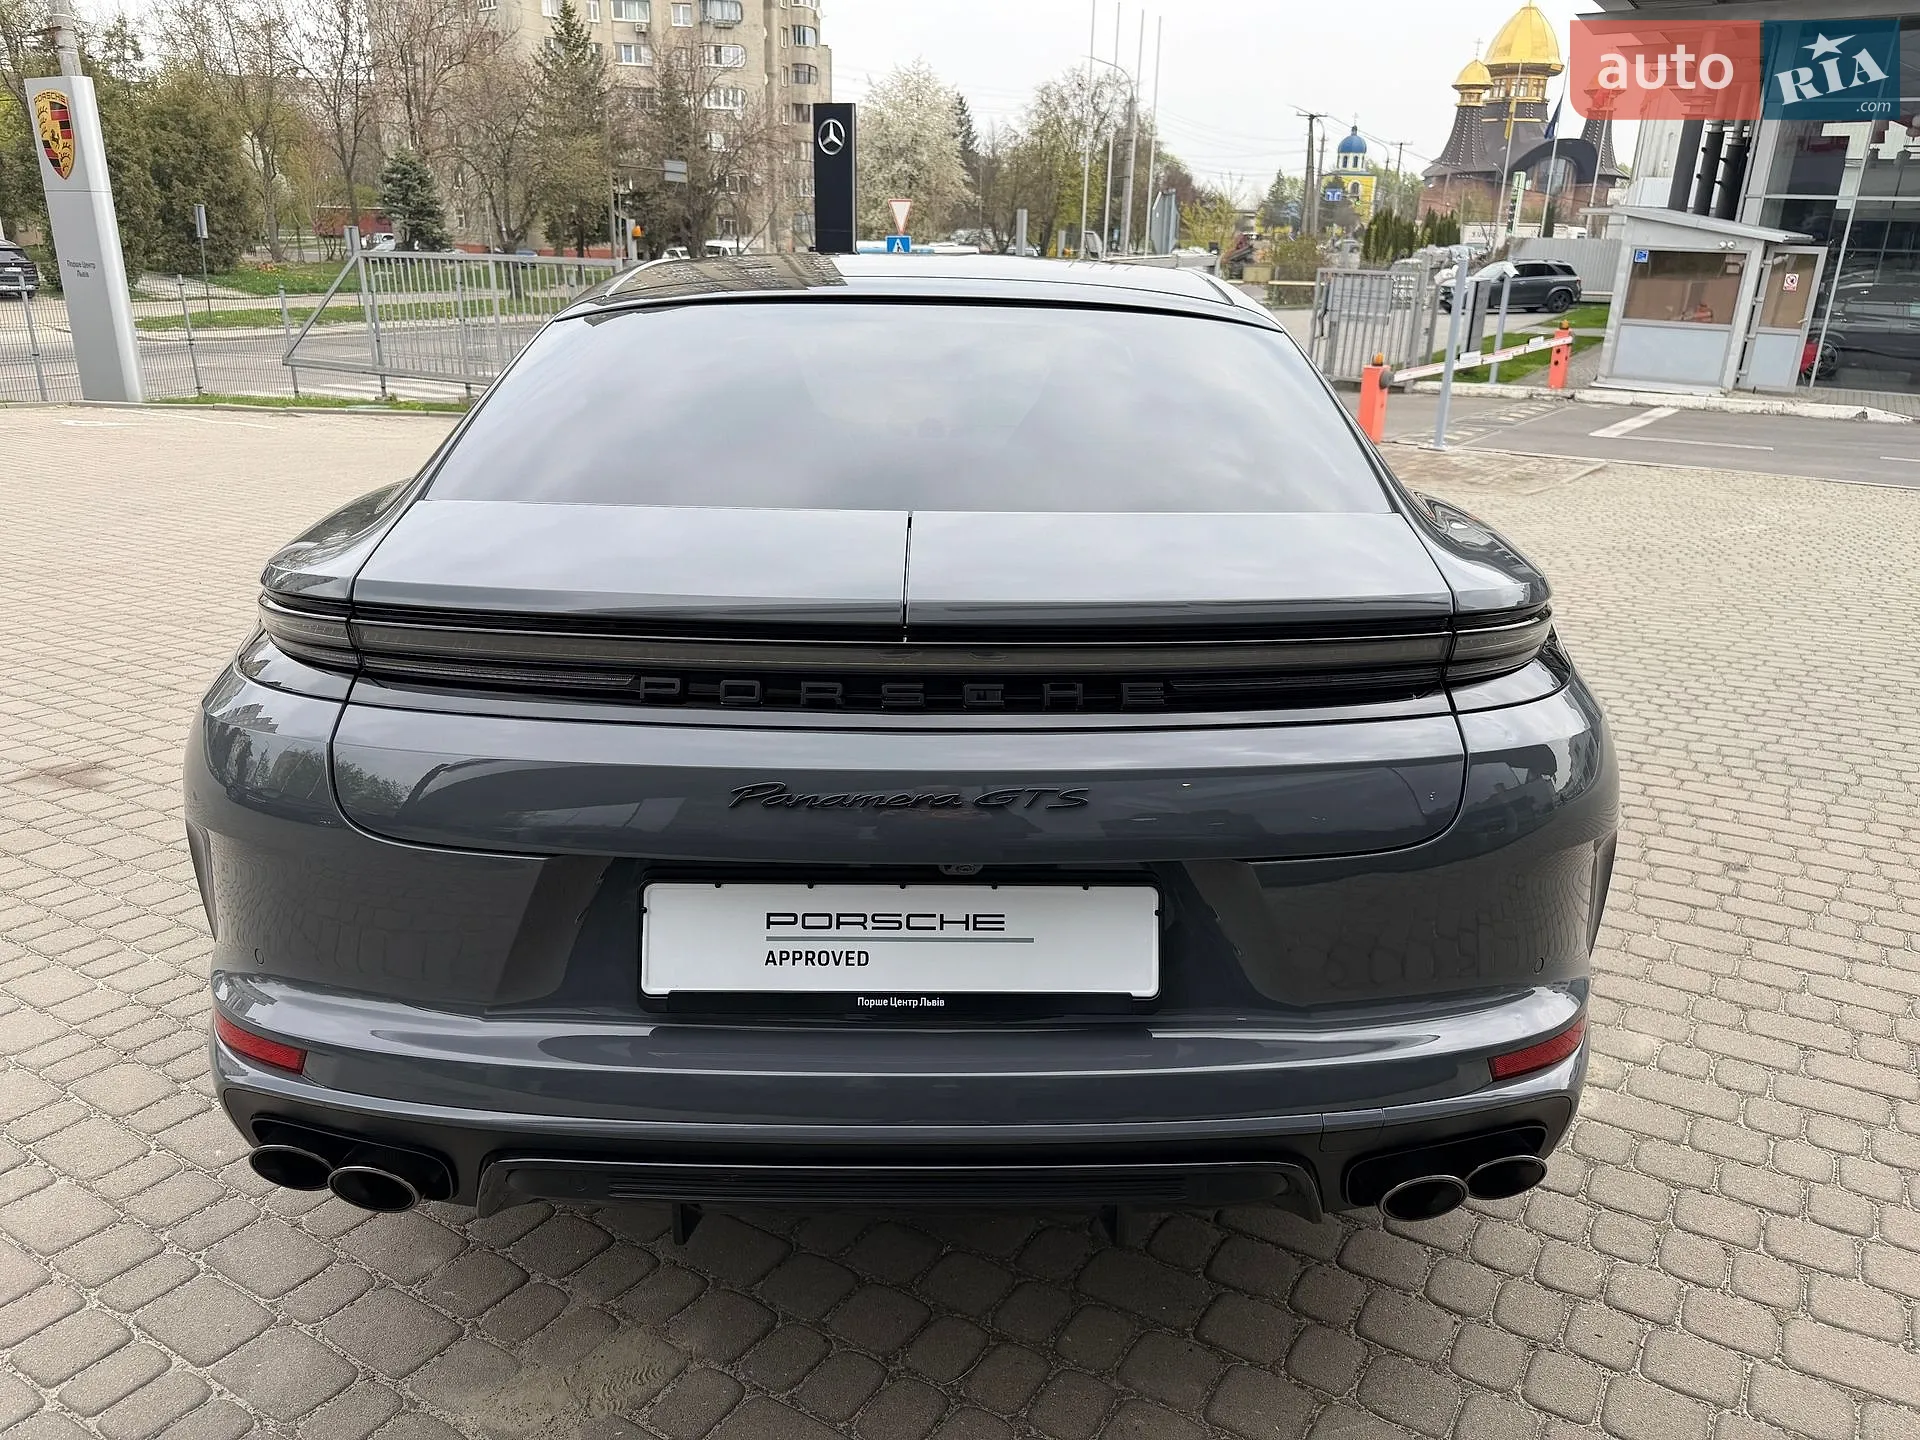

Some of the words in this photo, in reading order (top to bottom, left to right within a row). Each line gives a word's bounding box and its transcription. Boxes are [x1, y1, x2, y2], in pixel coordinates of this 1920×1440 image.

[638, 676, 1167, 710] PORSCHE
[728, 781, 963, 809] Panamera
[973, 787, 1090, 809] GTS
[765, 912, 1006, 931] PORSCHE
[764, 950, 870, 967] APPROVED
[857, 996, 889, 1009] Порше
[889, 996, 918, 1009] Центр
[919, 996, 945, 1007] Львів
